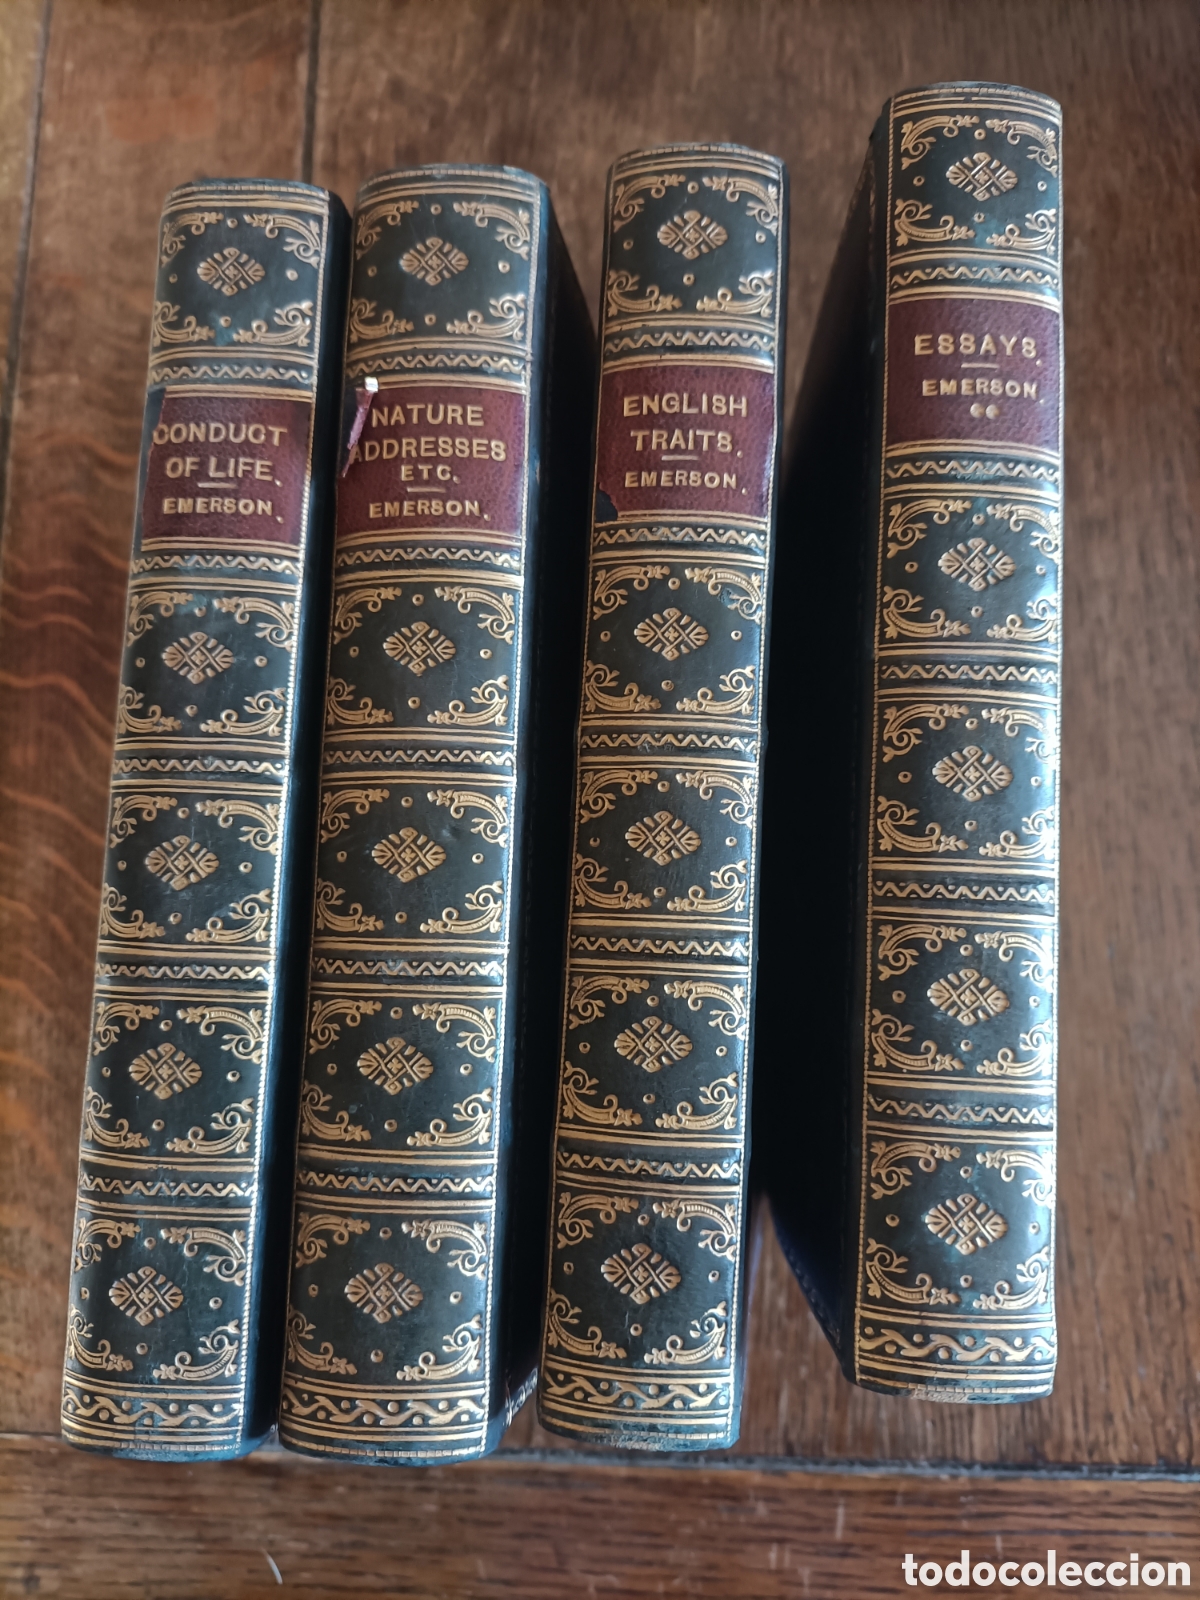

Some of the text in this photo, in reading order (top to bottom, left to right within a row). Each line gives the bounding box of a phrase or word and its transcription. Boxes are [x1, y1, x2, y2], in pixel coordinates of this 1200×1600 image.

[914, 332, 1042, 366] ESSAYS.
[922, 378, 1045, 404] EMERSON.
[371, 403, 484, 427] NATURE
[623, 392, 747, 417] ENGLISH
[153, 423, 287, 446] CONDUCT
[630, 428, 743, 458] TRAITS.
[166, 456, 283, 487] OF LIFE.
[401, 464, 461, 484] ETC.
[624, 470, 748, 495] EMERSON.
[163, 498, 284, 524] EMERSON.
[369, 500, 491, 521] EMERSON.
